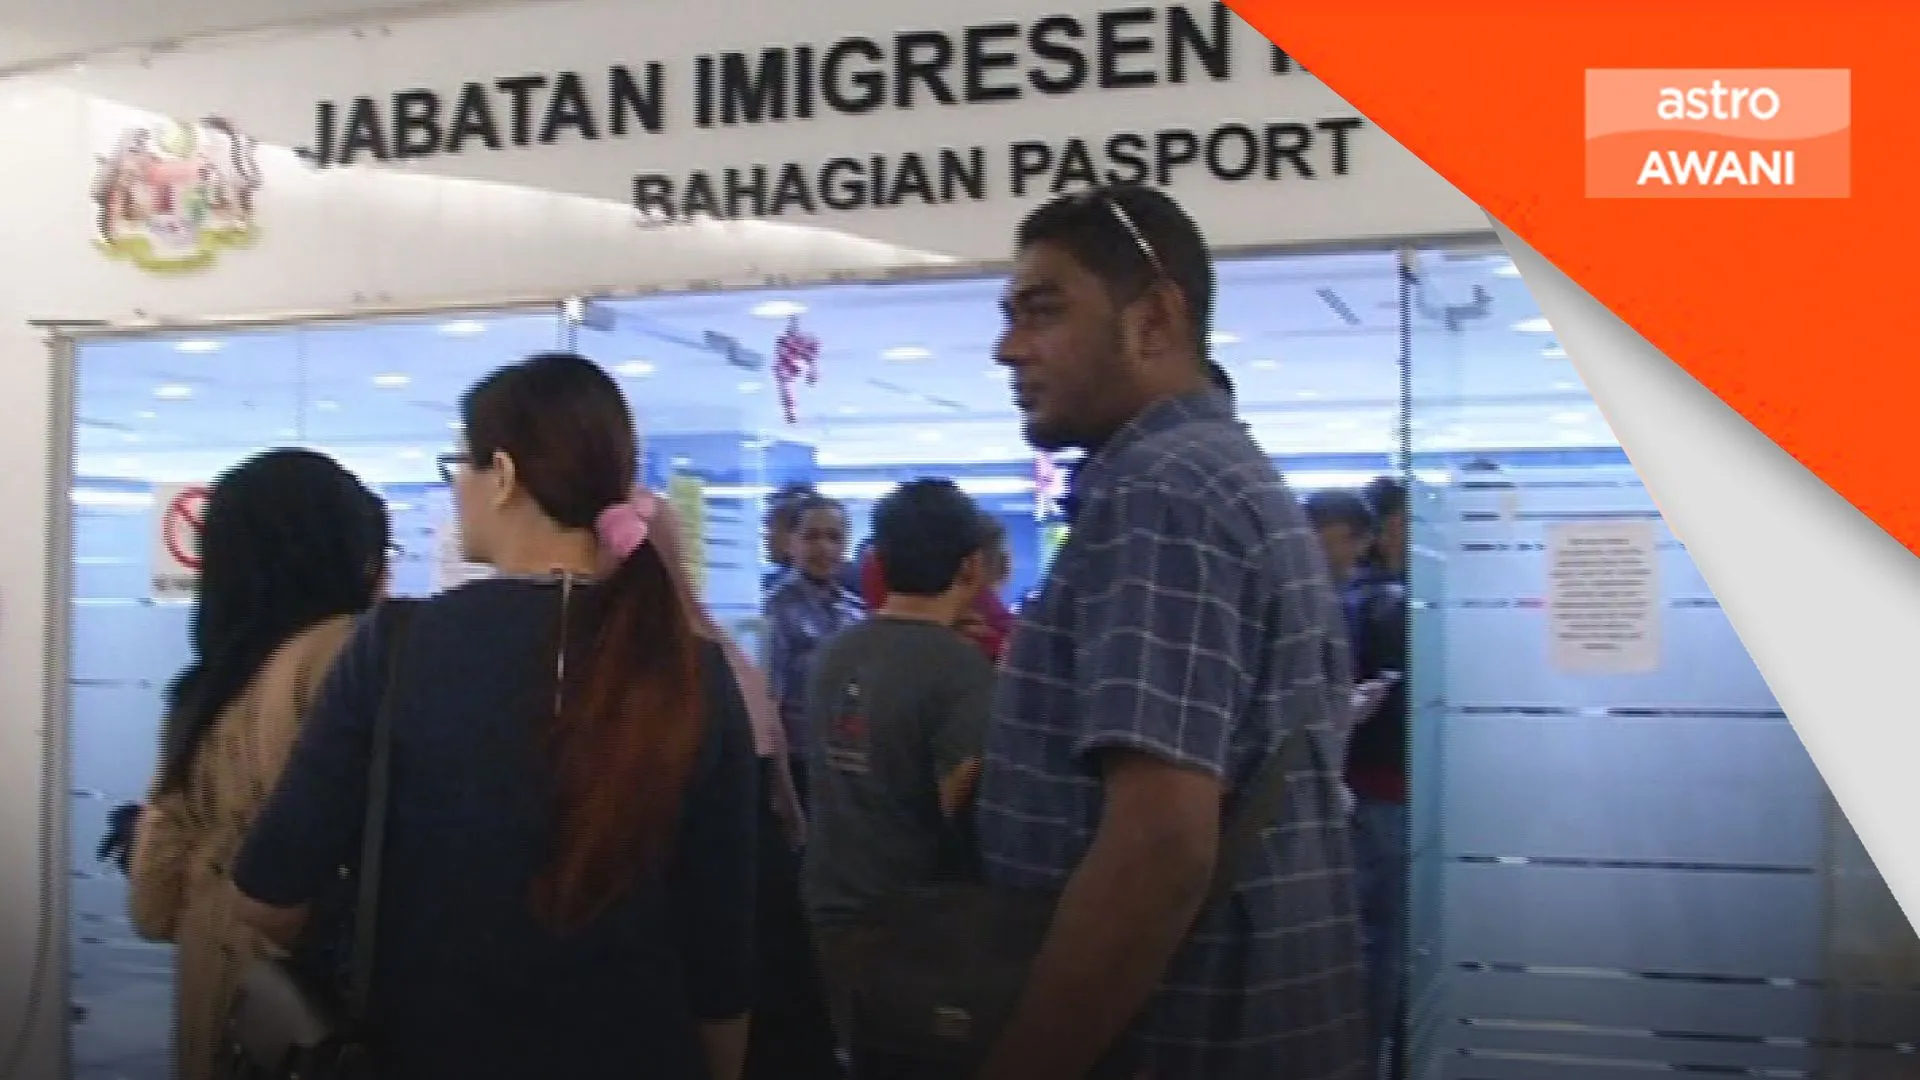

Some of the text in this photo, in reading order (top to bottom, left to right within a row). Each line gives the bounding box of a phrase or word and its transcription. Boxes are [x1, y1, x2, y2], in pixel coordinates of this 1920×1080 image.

[295, 3, 1231, 168] JABATAN IMIGRESEN
[632, 117, 1364, 226] BAHAGIAN PASPORT
